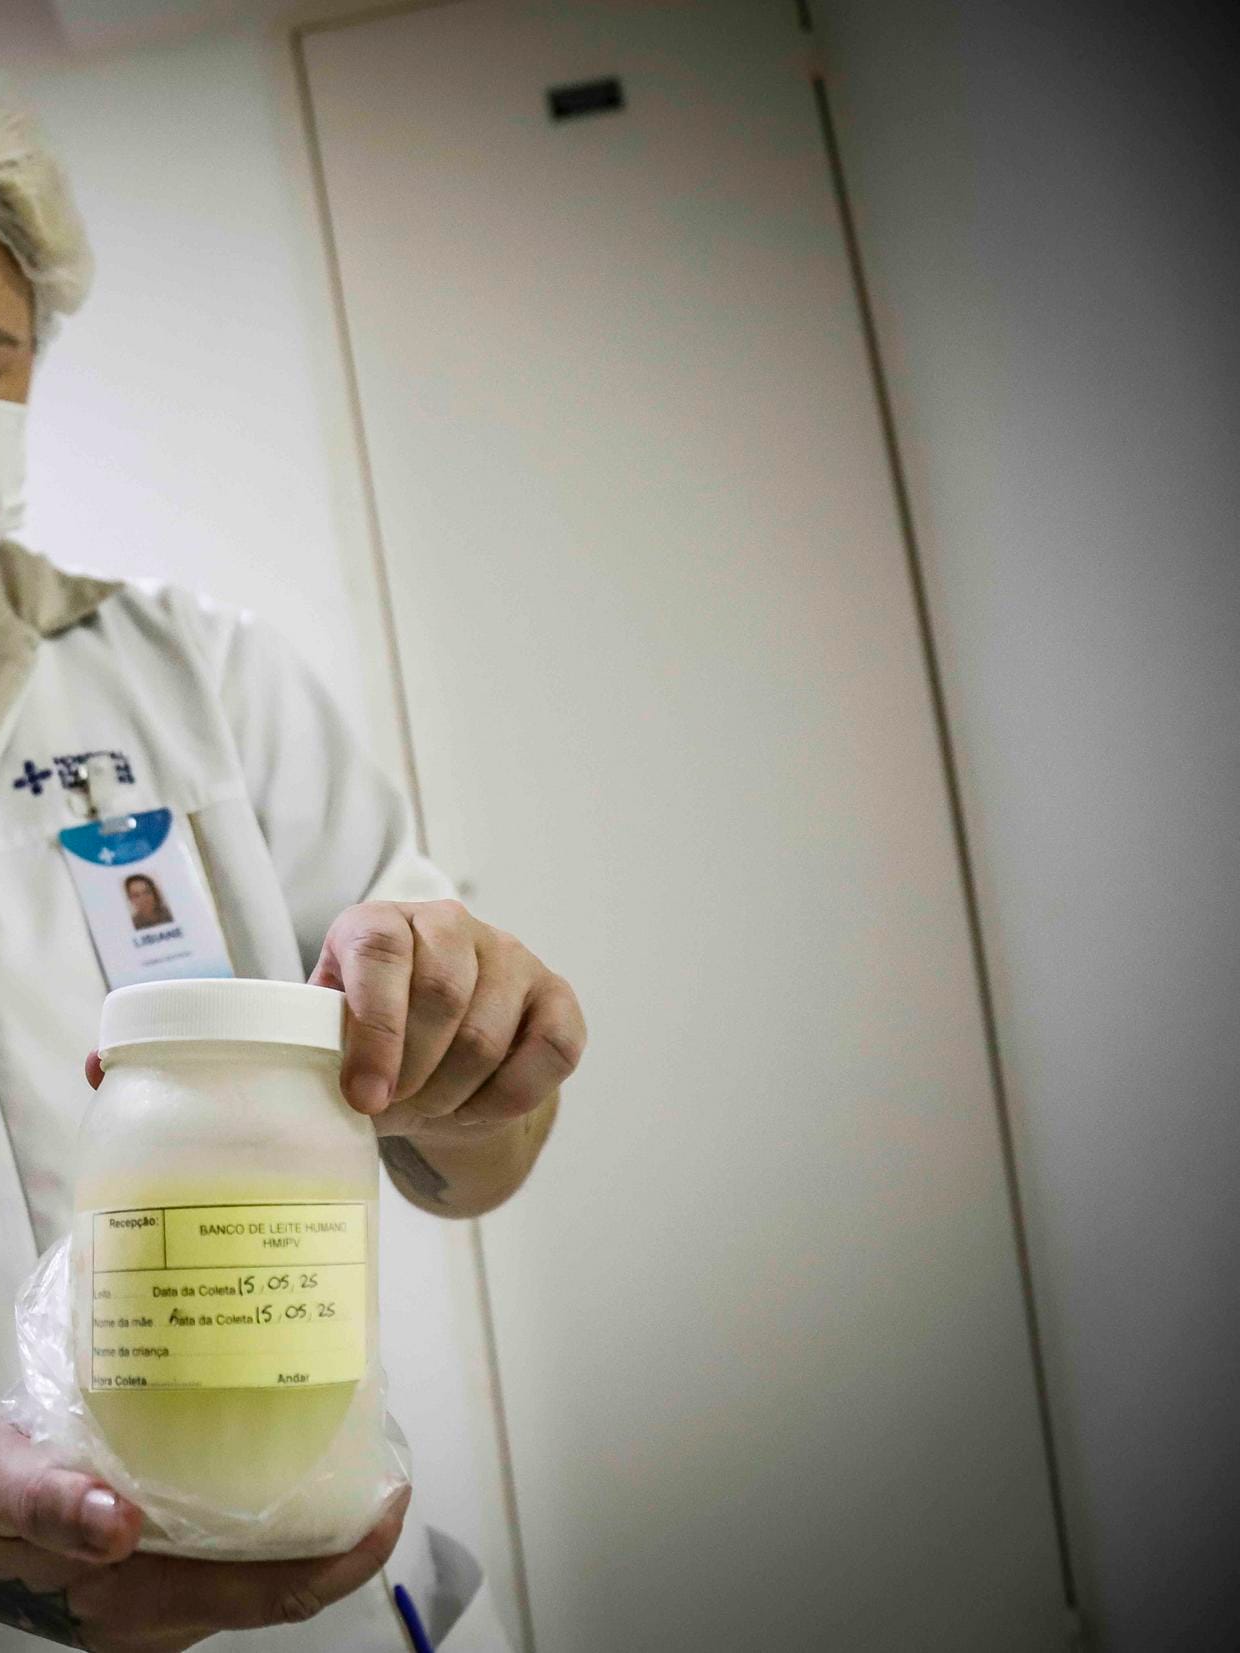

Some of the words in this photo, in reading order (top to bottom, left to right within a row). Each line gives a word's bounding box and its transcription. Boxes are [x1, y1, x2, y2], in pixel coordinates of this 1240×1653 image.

[109, 1215, 159, 1230] Recepção:
[199, 1224, 245, 1236] BANCO
[248, 1223, 266, 1235] DE
[270, 1222, 301, 1234] LEITE
[152, 1286, 178, 1298] Data
[181, 1285, 195, 1297] da
[198, 1284, 236, 1297] Coleta
[117, 1317, 130, 1328] da
[198, 1315, 213, 1327] da
[216, 1313, 254, 1326] Coleta
[118, 1346, 130, 1357] da
[132, 1346, 169, 1360] criança
[115, 1374, 148, 1386] Coleta
